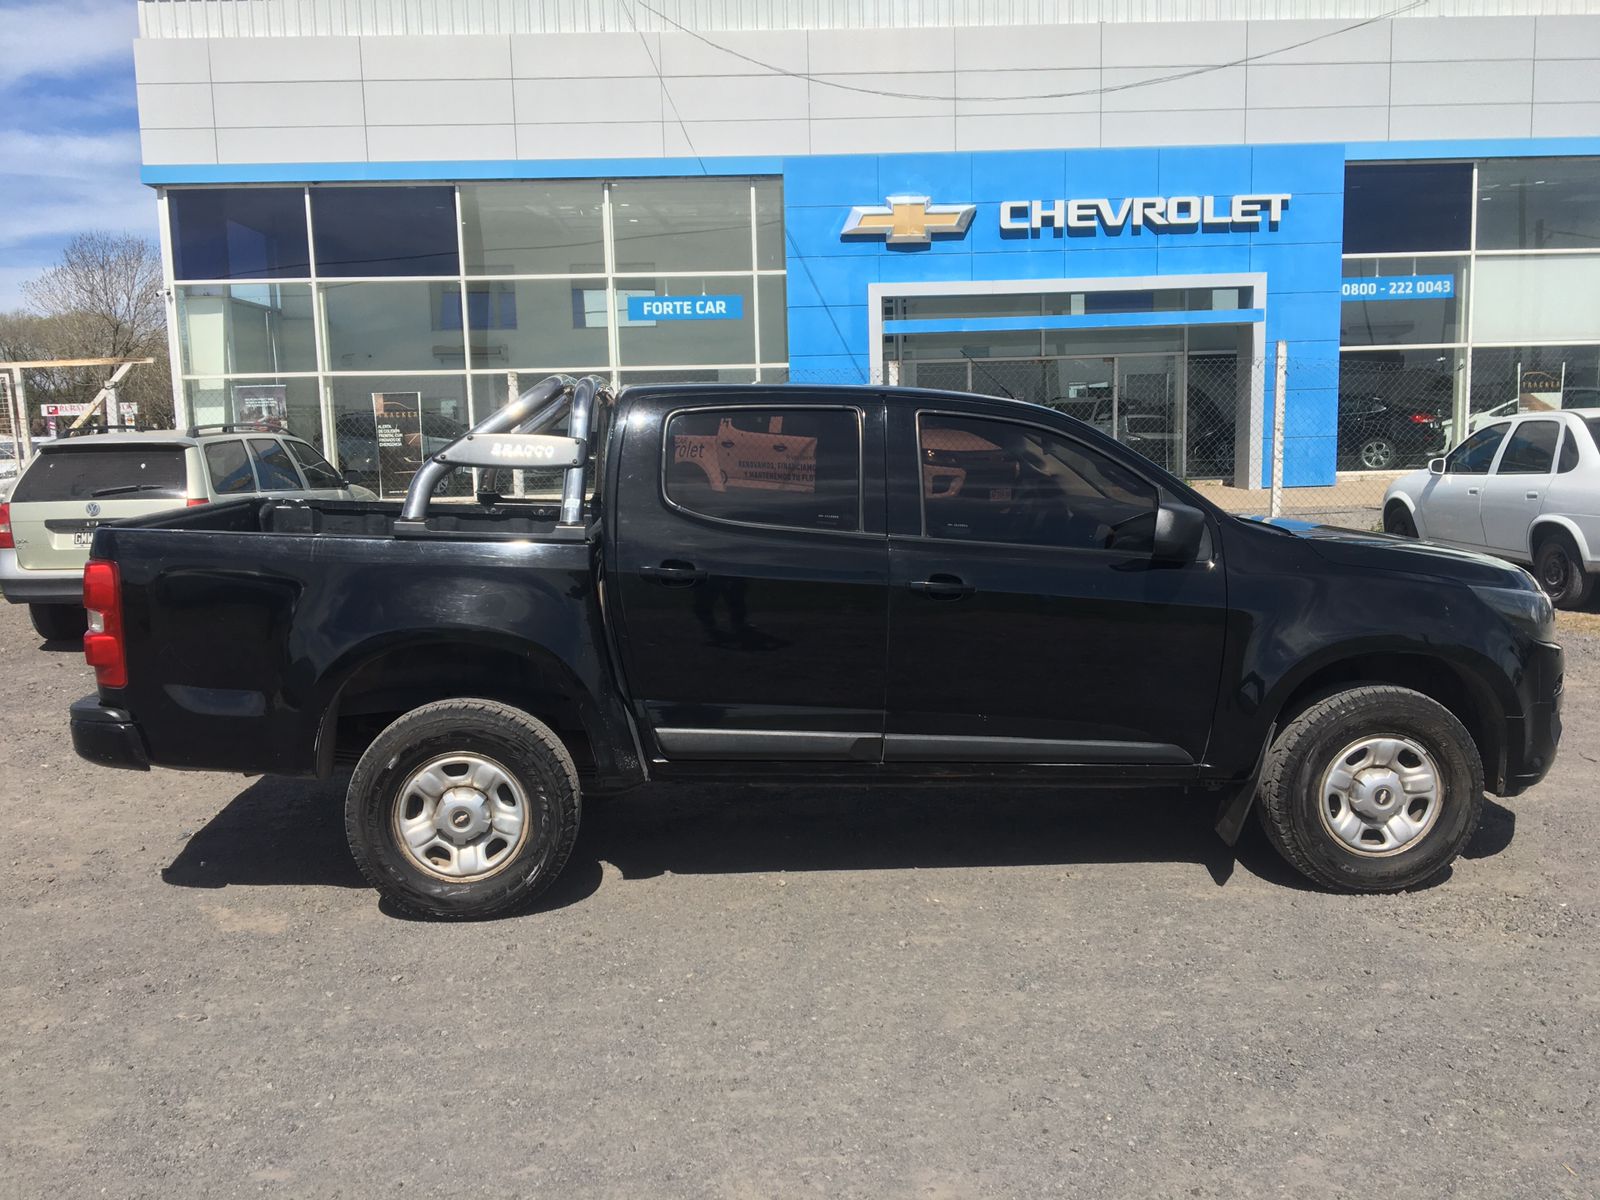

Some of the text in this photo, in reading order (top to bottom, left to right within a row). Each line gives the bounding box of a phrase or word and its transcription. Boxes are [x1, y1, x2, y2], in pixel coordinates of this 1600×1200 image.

[1000, 194, 1292, 229] CHEVROLET
[1341, 283, 1377, 296] 0800
[1388, 282, 1413, 295] 222
[1416, 280, 1451, 293] 0043
[643, 300, 727, 315] FORTE CAR
[675, 441, 704, 458] rolet
